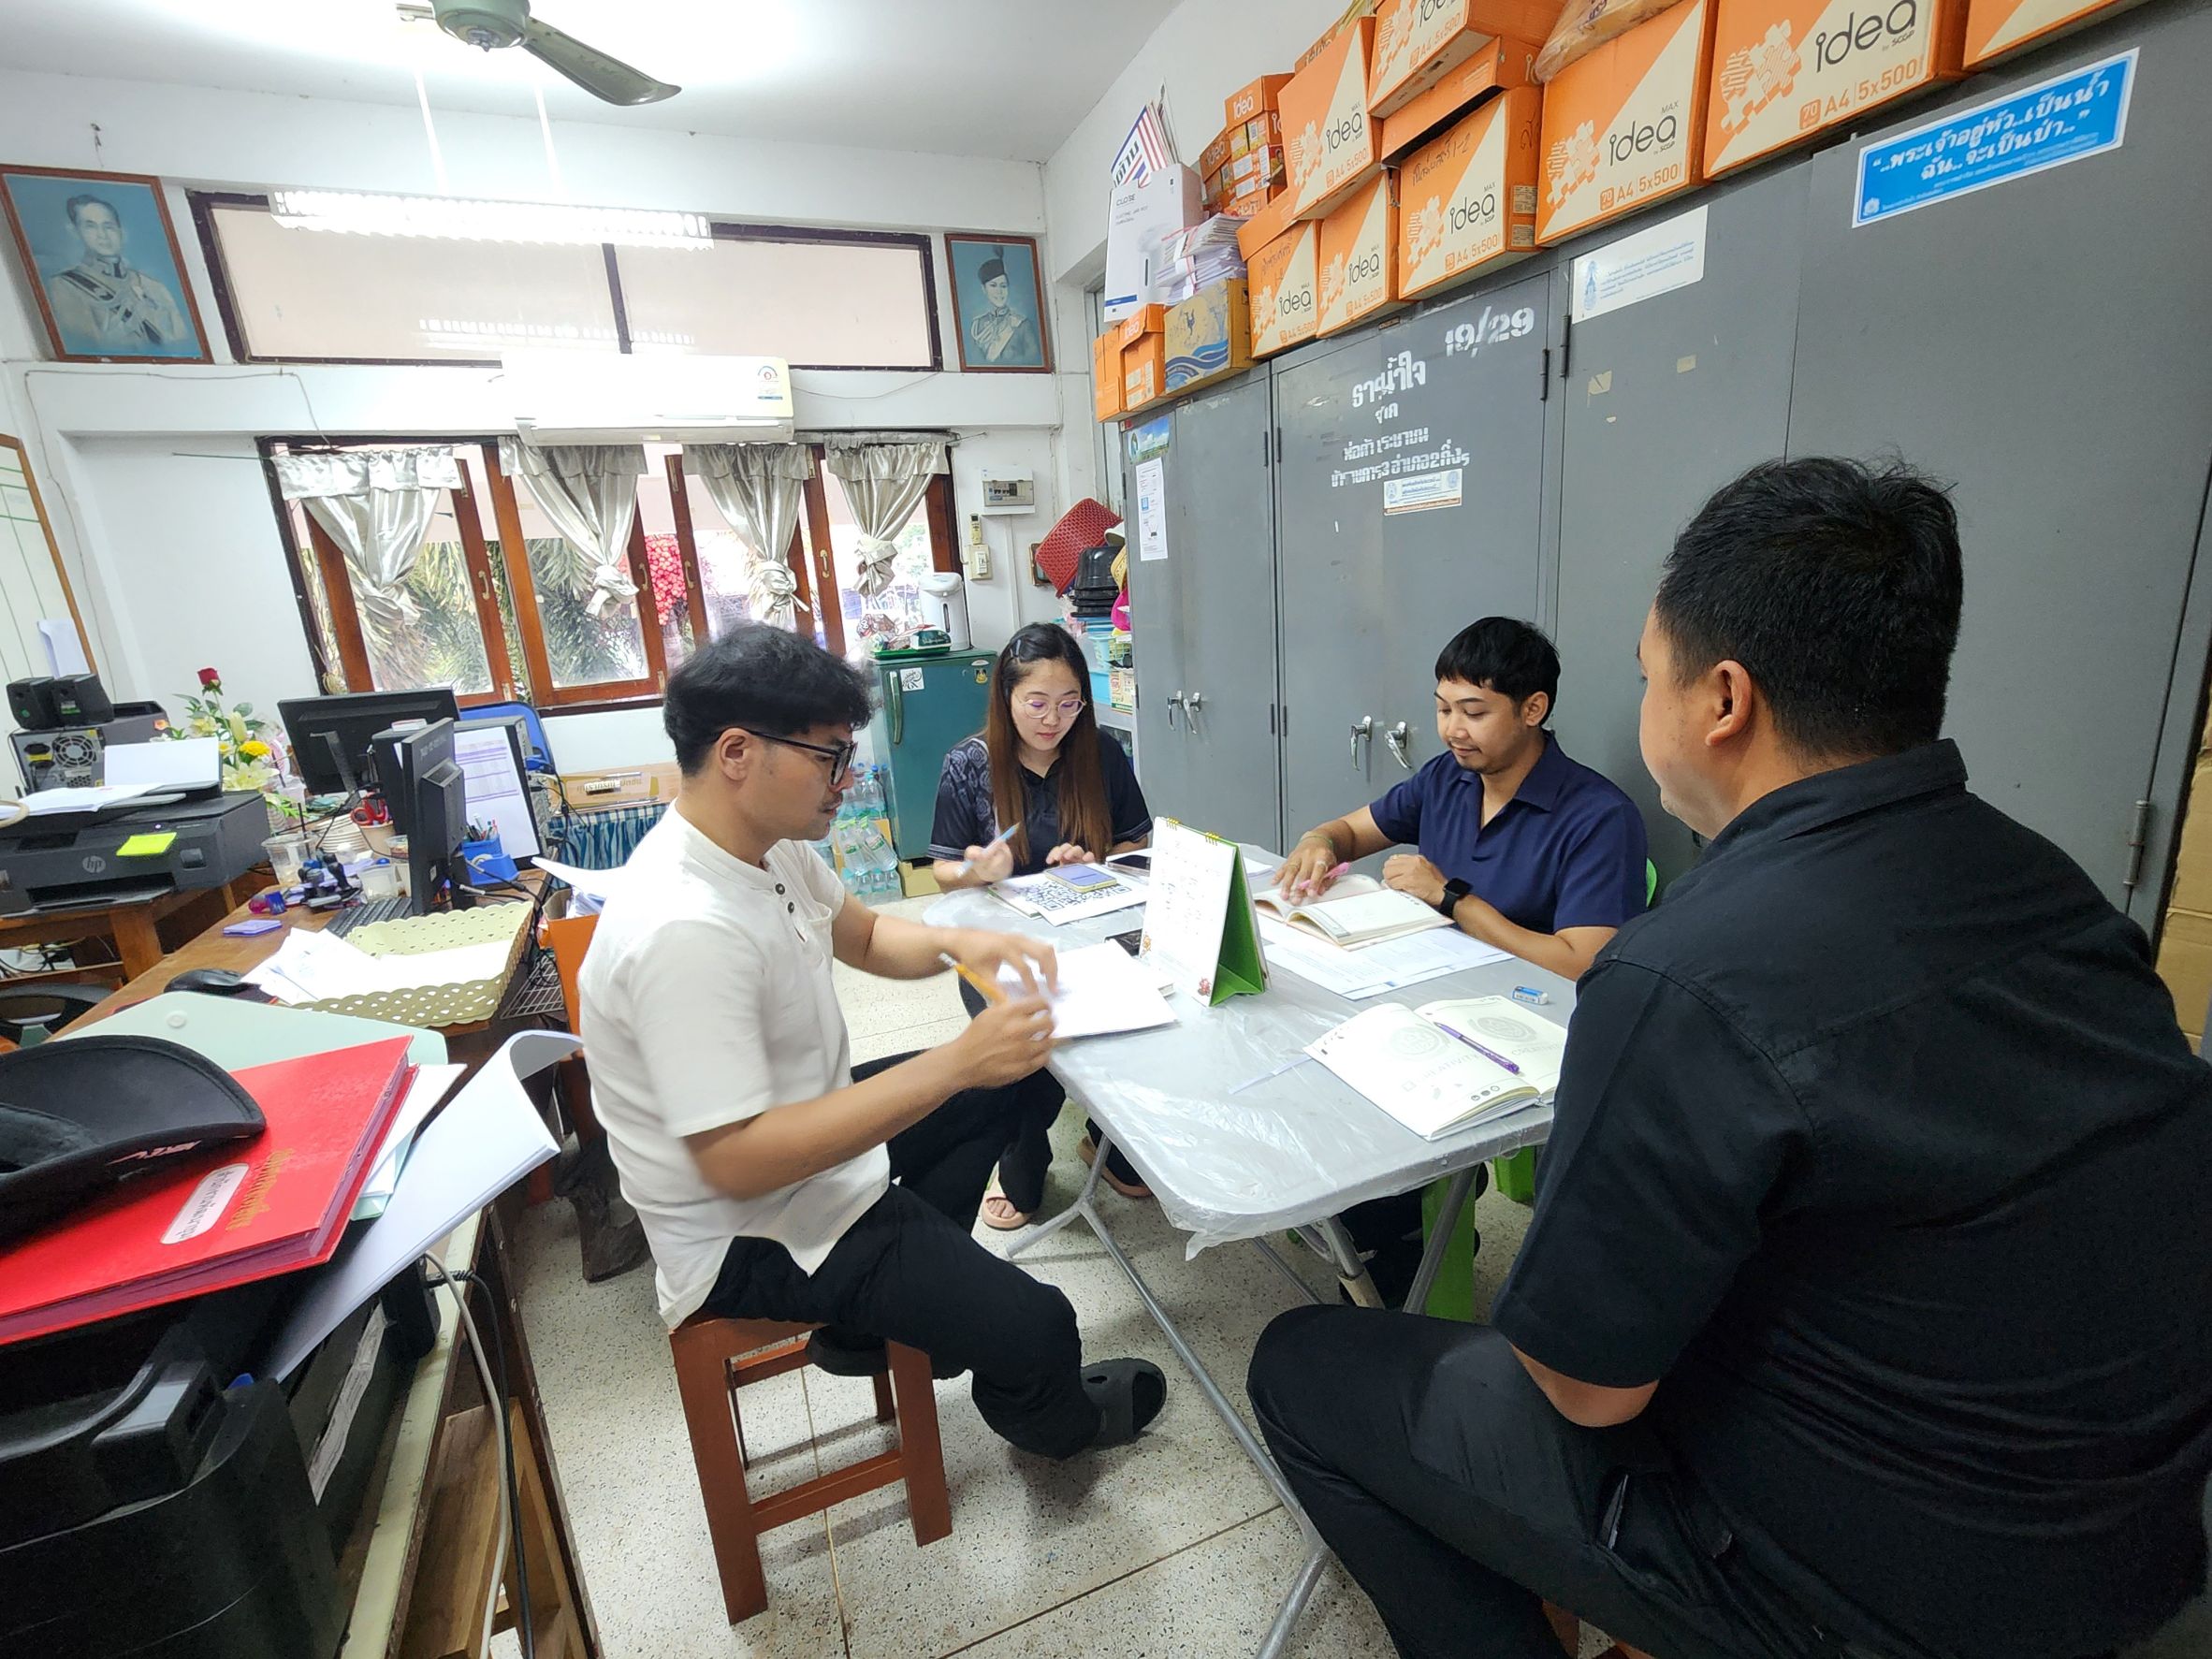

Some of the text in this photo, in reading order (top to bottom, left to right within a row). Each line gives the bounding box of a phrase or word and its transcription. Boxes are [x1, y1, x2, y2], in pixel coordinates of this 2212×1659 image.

[1814, 0, 1917, 73] idea
[1825, 89, 1850, 117] A4
[1857, 57, 1917, 101] 5x500
[1325, 112, 1362, 153] idea
[1608, 115, 1677, 167] idea
[1616, 183, 1634, 203] A4
[1638, 163, 1679, 193] 5x500
[1449, 193, 1495, 235] idea
[1456, 249, 1469, 264] A4
[1471, 234, 1498, 257] 5x500
[1348, 254, 1380, 286] idea
[1278, 290, 1312, 317] idea
[1445, 306, 1535, 358] 19/29
[84, 855, 105, 873] hp
